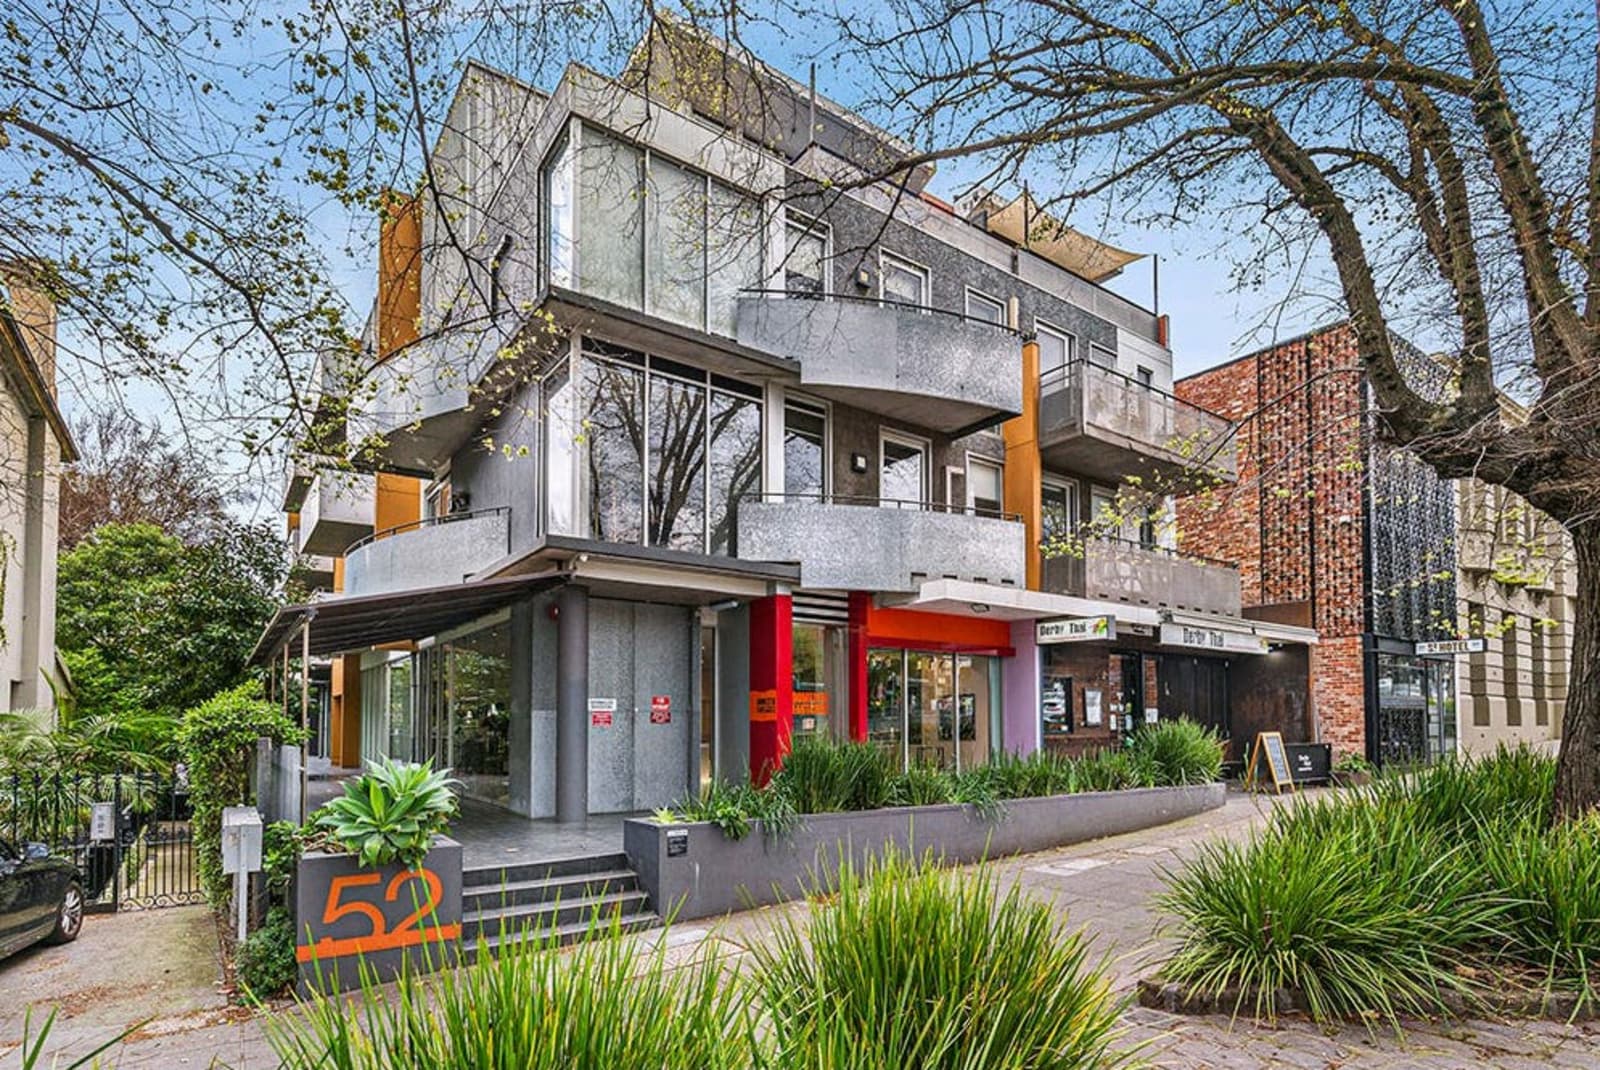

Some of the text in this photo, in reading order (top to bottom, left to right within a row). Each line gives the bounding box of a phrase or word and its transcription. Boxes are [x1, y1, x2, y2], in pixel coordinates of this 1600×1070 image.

[1039, 621, 1087, 637] Derby Thai
[1183, 626, 1225, 648] Derby Thai
[1439, 640, 1469, 653] HOTEL
[320, 868, 444, 946] 52
